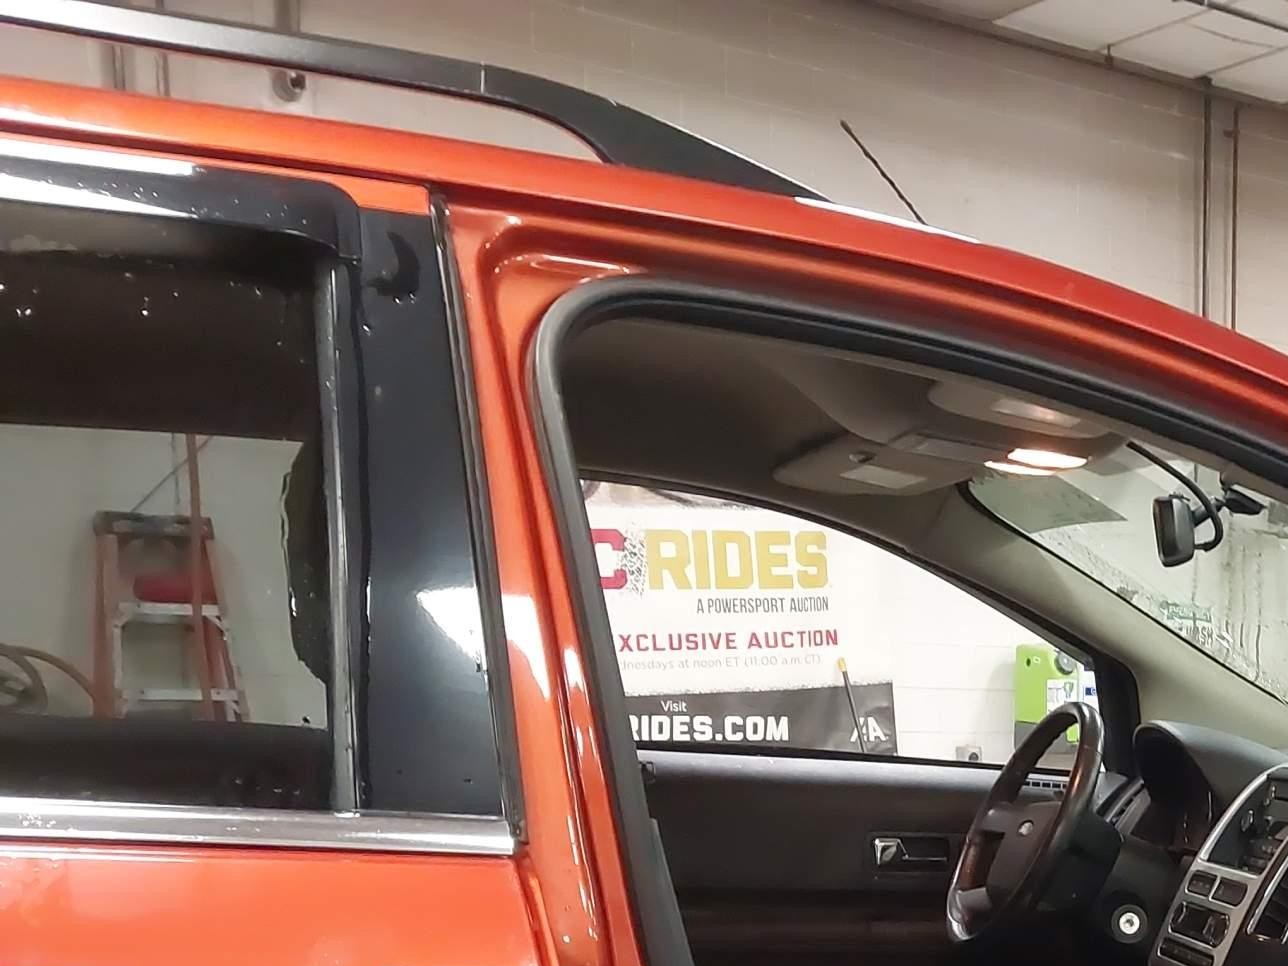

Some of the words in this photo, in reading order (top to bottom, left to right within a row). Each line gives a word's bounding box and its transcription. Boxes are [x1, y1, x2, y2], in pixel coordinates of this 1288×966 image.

[645, 529, 829, 589] RIDES
[696, 598, 704, 614] A
[707, 597, 785, 614] POWERSPORT
[789, 596, 830, 613] AUCTION
[618, 632, 738, 652] XCLUSIVE
[747, 628, 839, 649] AUCTION
[678, 658, 689, 669] at
[692, 658, 721, 669] noon
[725, 656, 740, 668] ET
[660, 699, 687, 713] Visit
[628, 714, 790, 742] RIDES.COM
